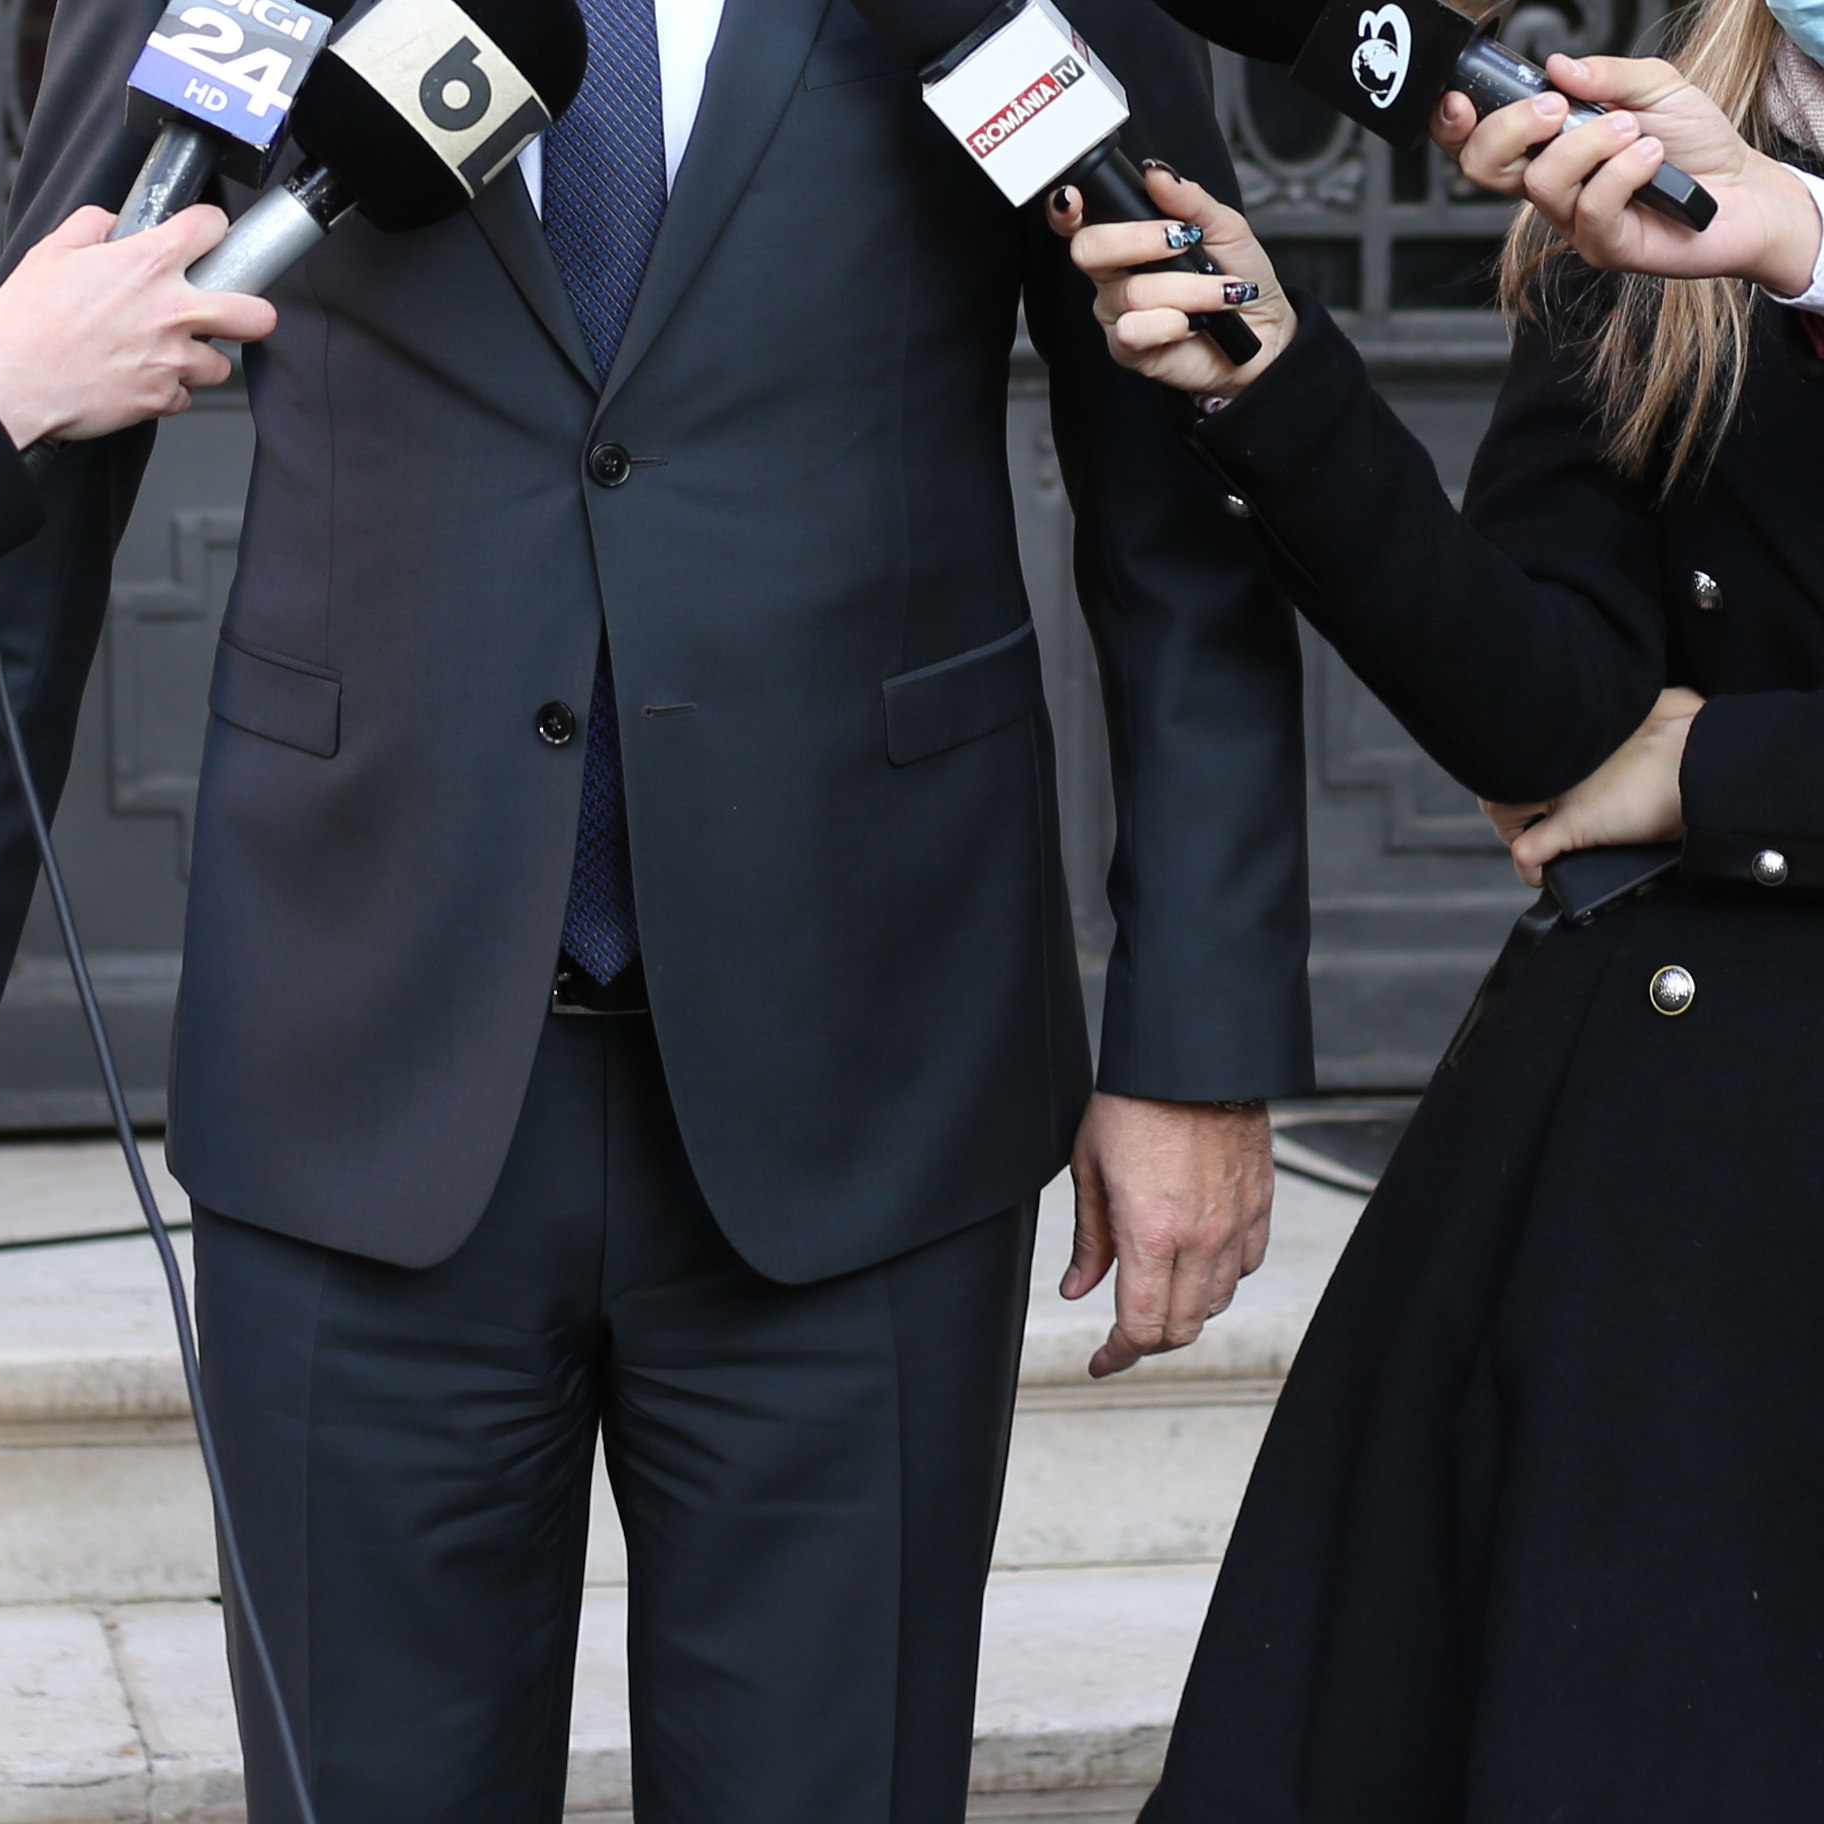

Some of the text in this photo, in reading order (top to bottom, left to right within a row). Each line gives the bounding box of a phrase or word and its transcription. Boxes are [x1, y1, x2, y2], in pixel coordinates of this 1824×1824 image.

[147, 5, 293, 118] 24
[183, 77, 228, 112] HD
[419, 36, 492, 132] 6
[972, 59, 1080, 155] ROMÂNIA TV
